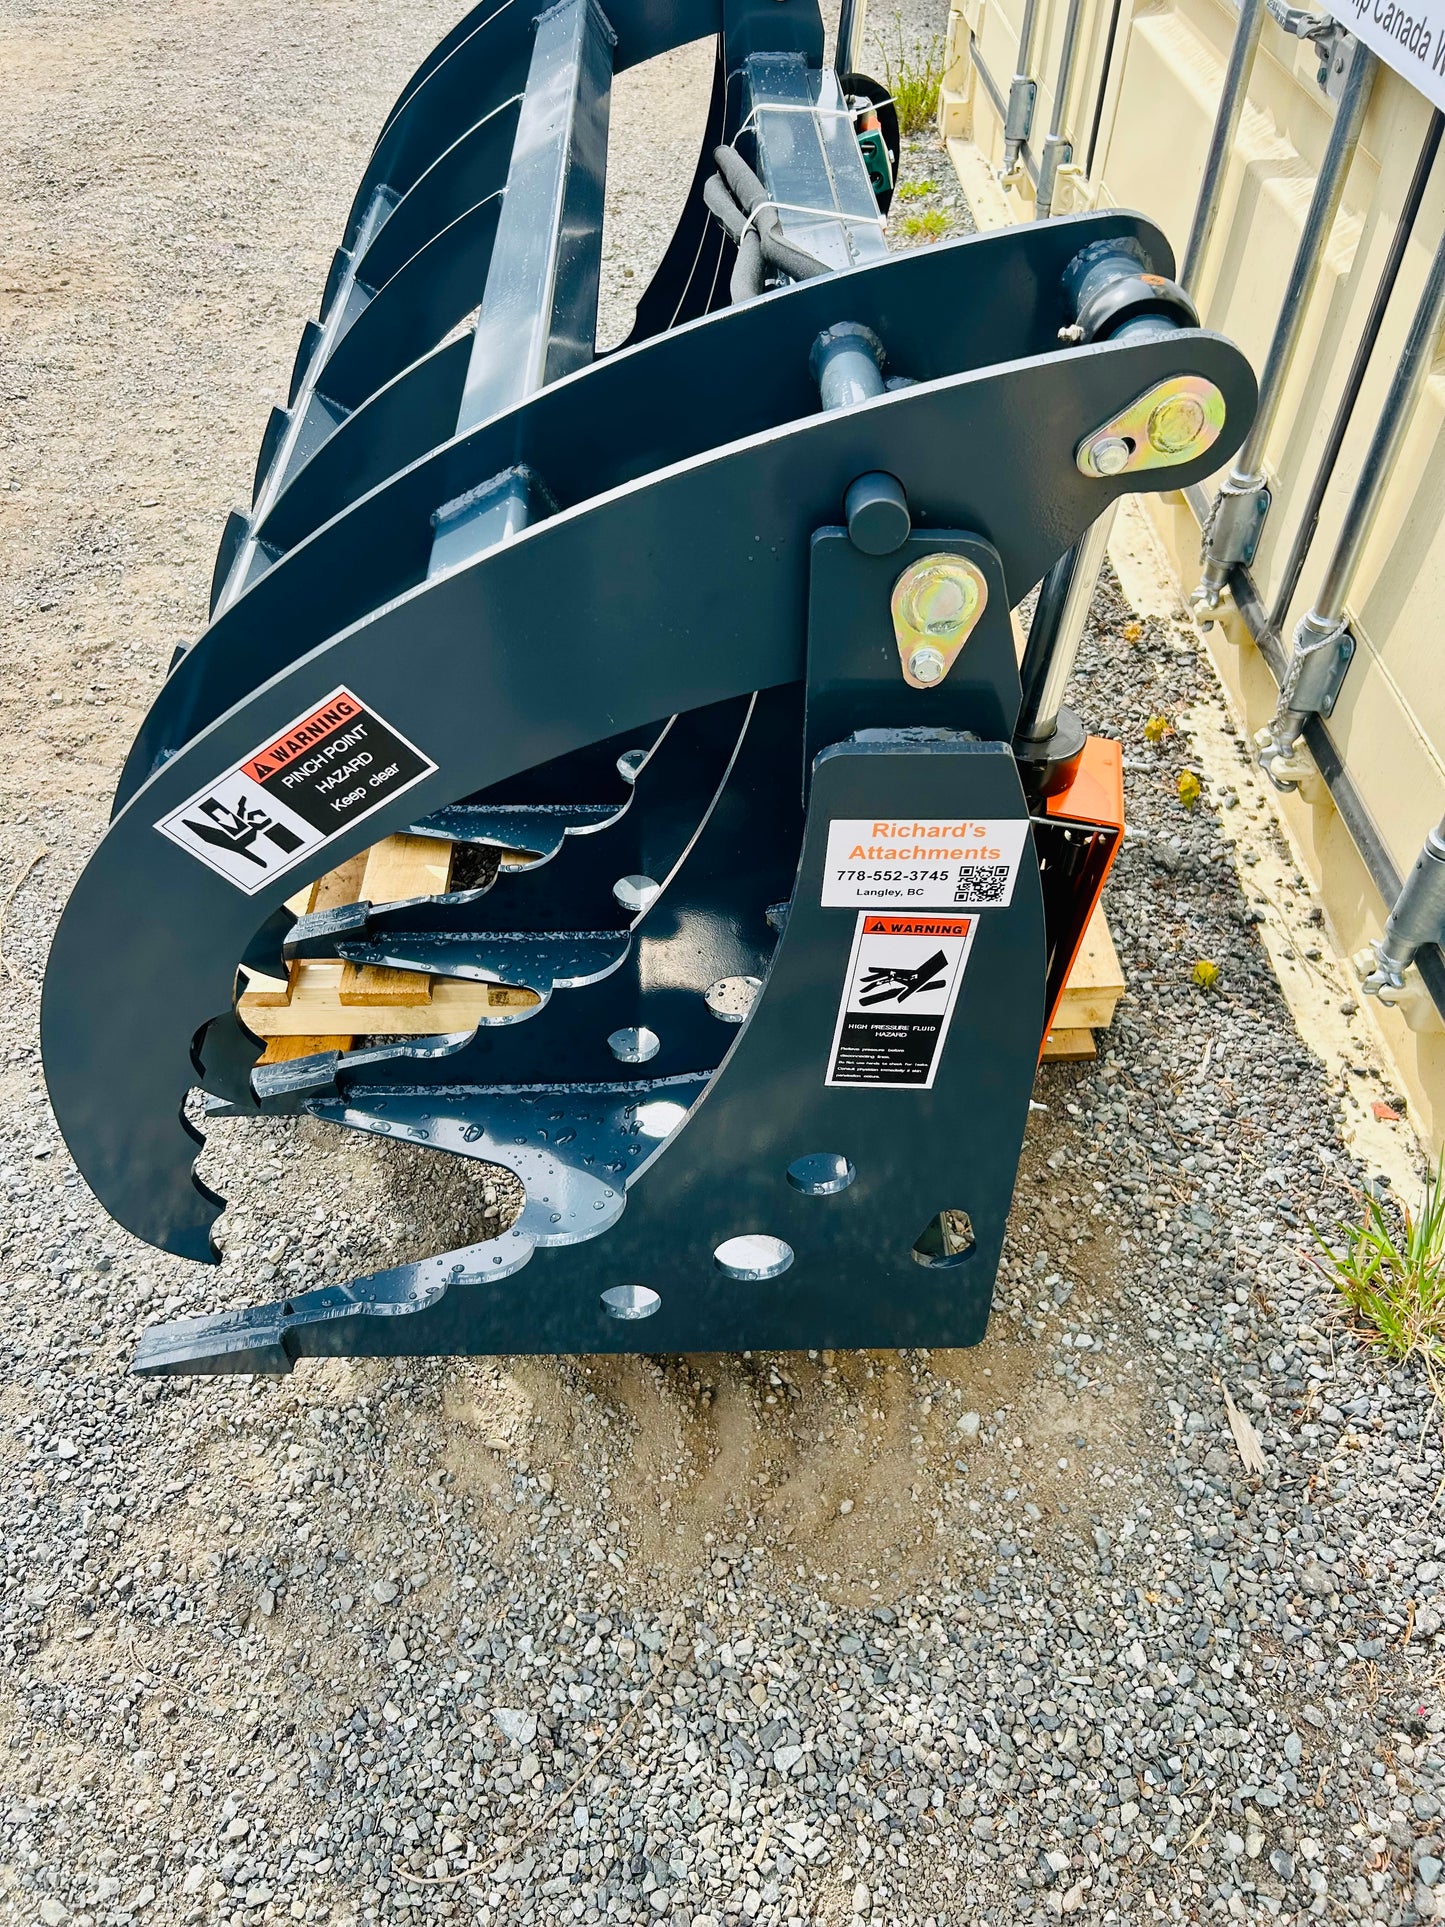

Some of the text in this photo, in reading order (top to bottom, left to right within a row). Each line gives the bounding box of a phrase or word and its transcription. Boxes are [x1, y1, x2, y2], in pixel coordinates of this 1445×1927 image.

[1374, 0, 1432, 61] Canada
[269, 701, 355, 763] WARNING
[281, 723, 369, 789] PINCH POINT
[314, 752, 374, 794] HAZARD
[330, 762, 400, 812] Keep clear
[872, 823, 987, 838] Richard's
[849, 845, 1001, 860] Attachments
[837, 870, 949, 881] 778-552-3745
[857, 888, 924, 896] Langley, BC
[891, 924, 962, 934] WARNING
